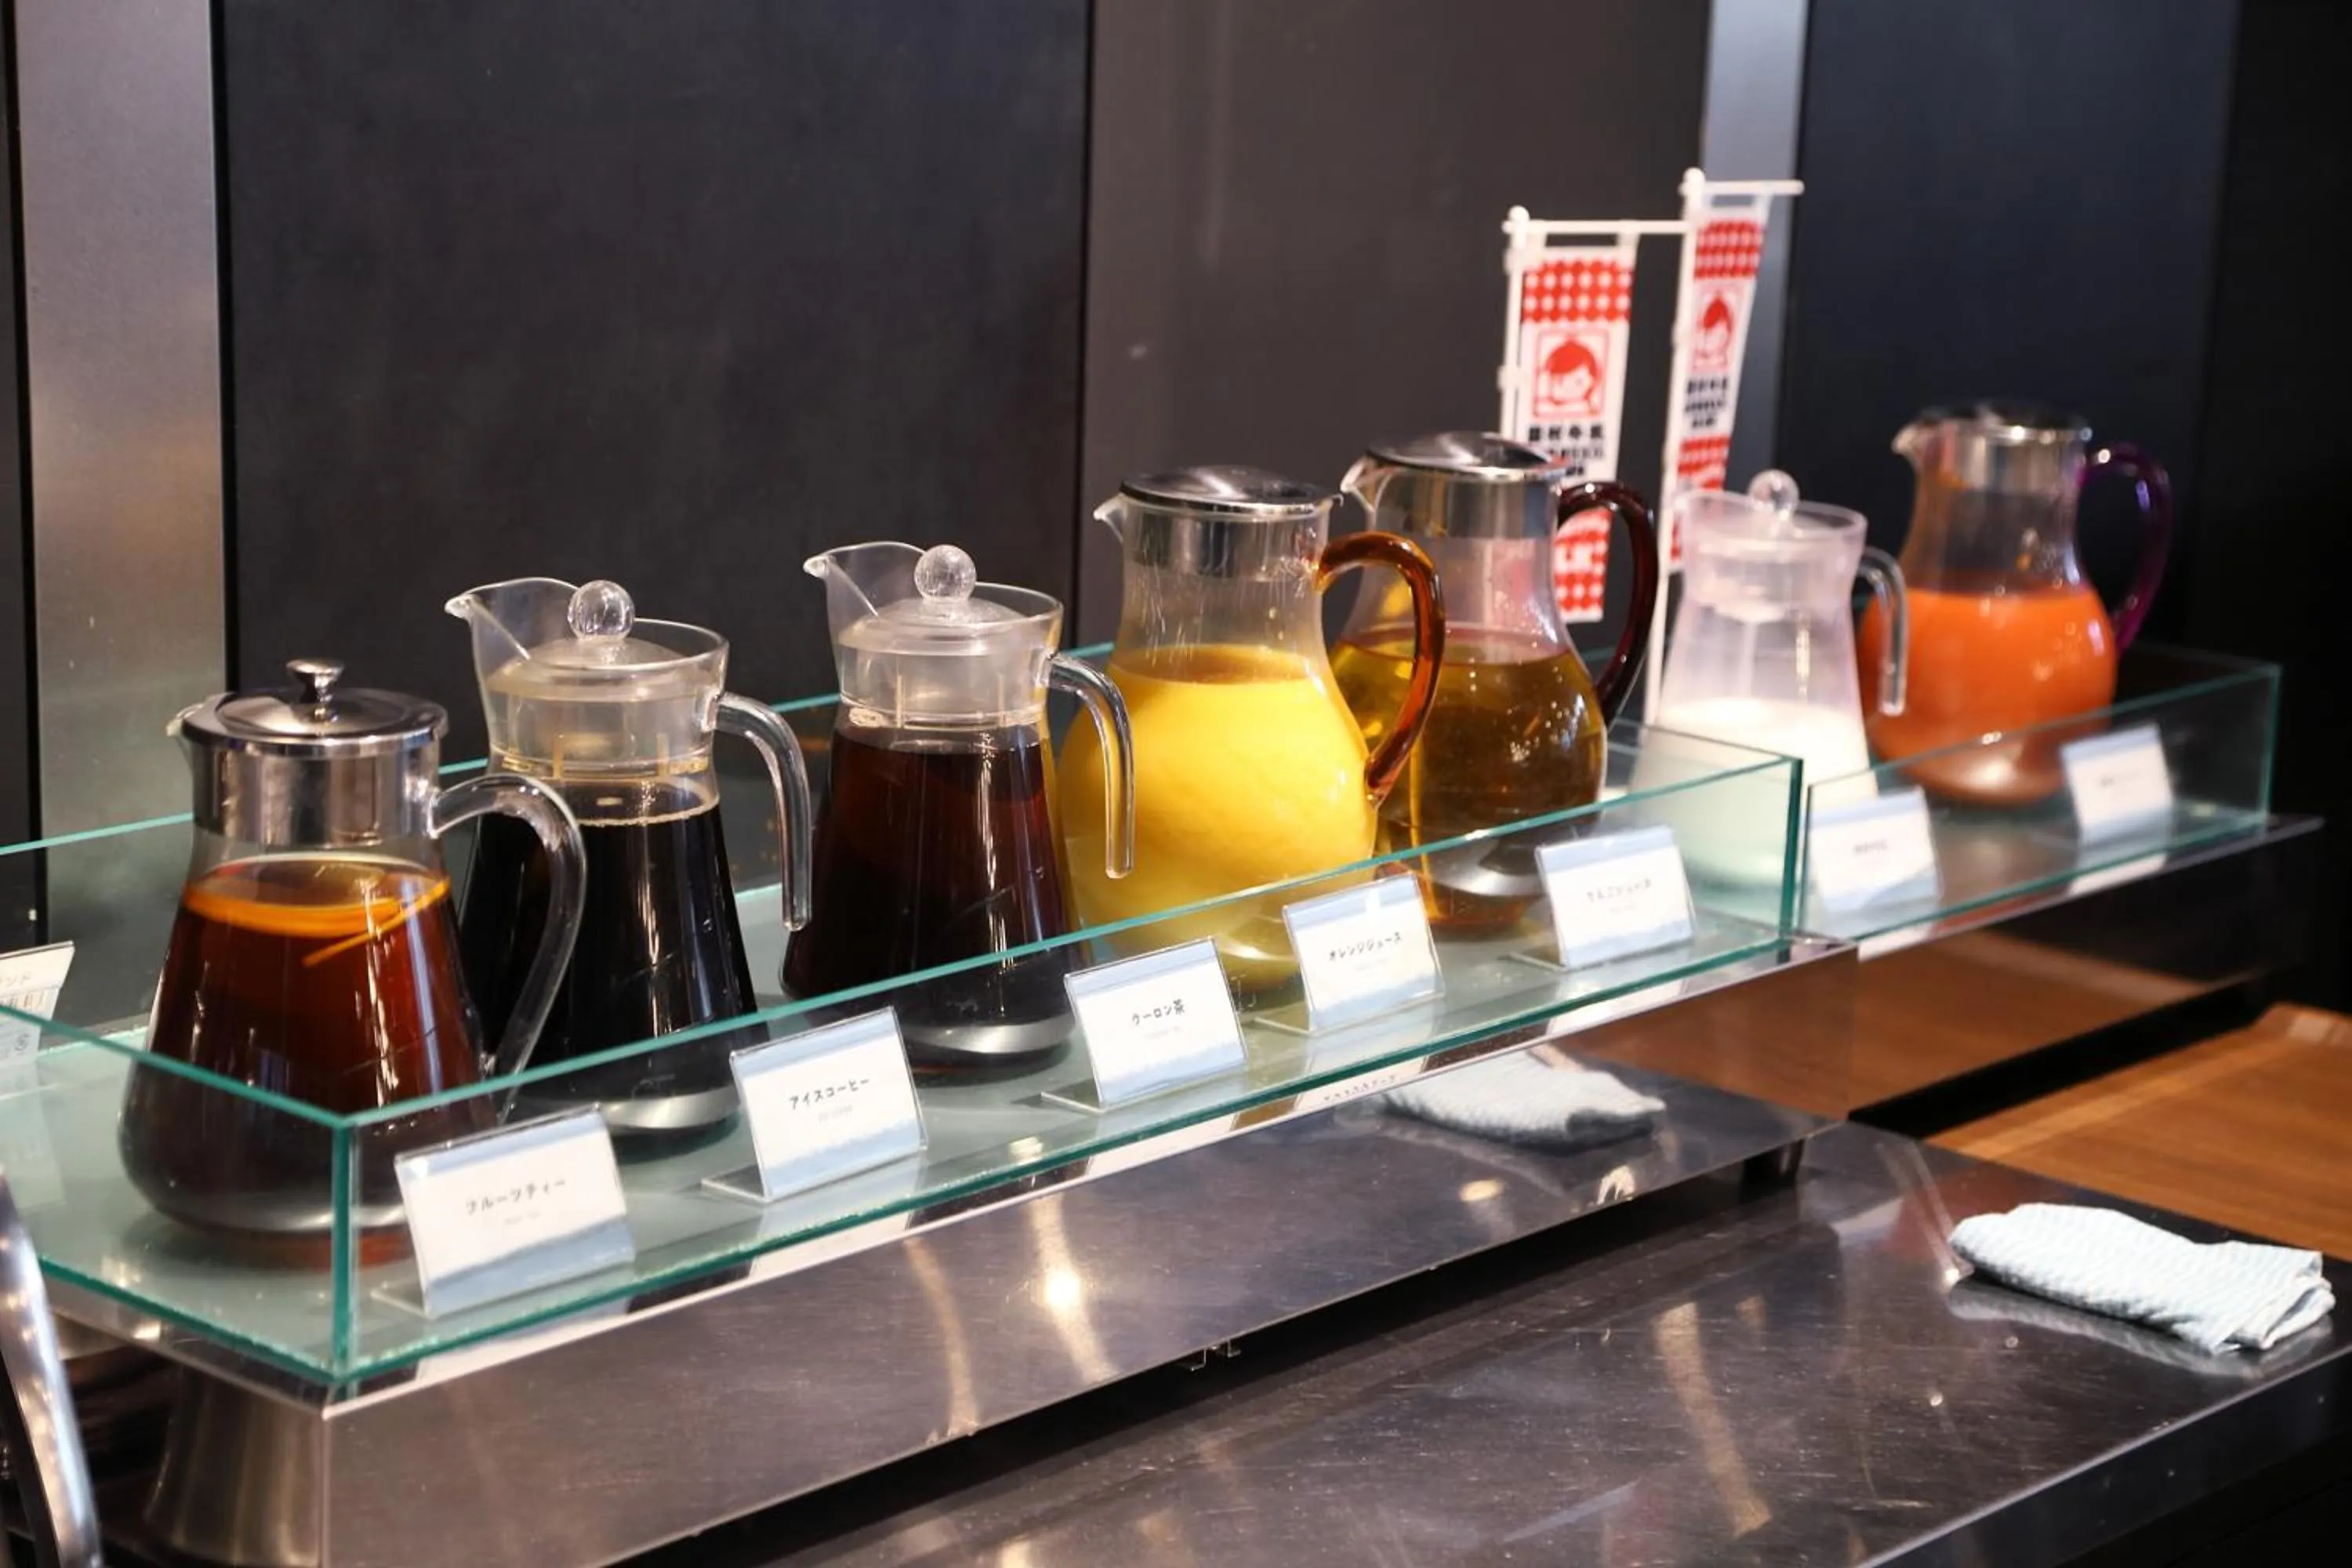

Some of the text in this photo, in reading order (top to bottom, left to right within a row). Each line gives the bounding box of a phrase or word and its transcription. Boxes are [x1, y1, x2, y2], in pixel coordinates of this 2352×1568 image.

[1131, 998, 1185, 1025] ウーロン茶
[789, 1079, 870, 1110] アイスコーヒー
[466, 1179, 566, 1215] フルーツティー
